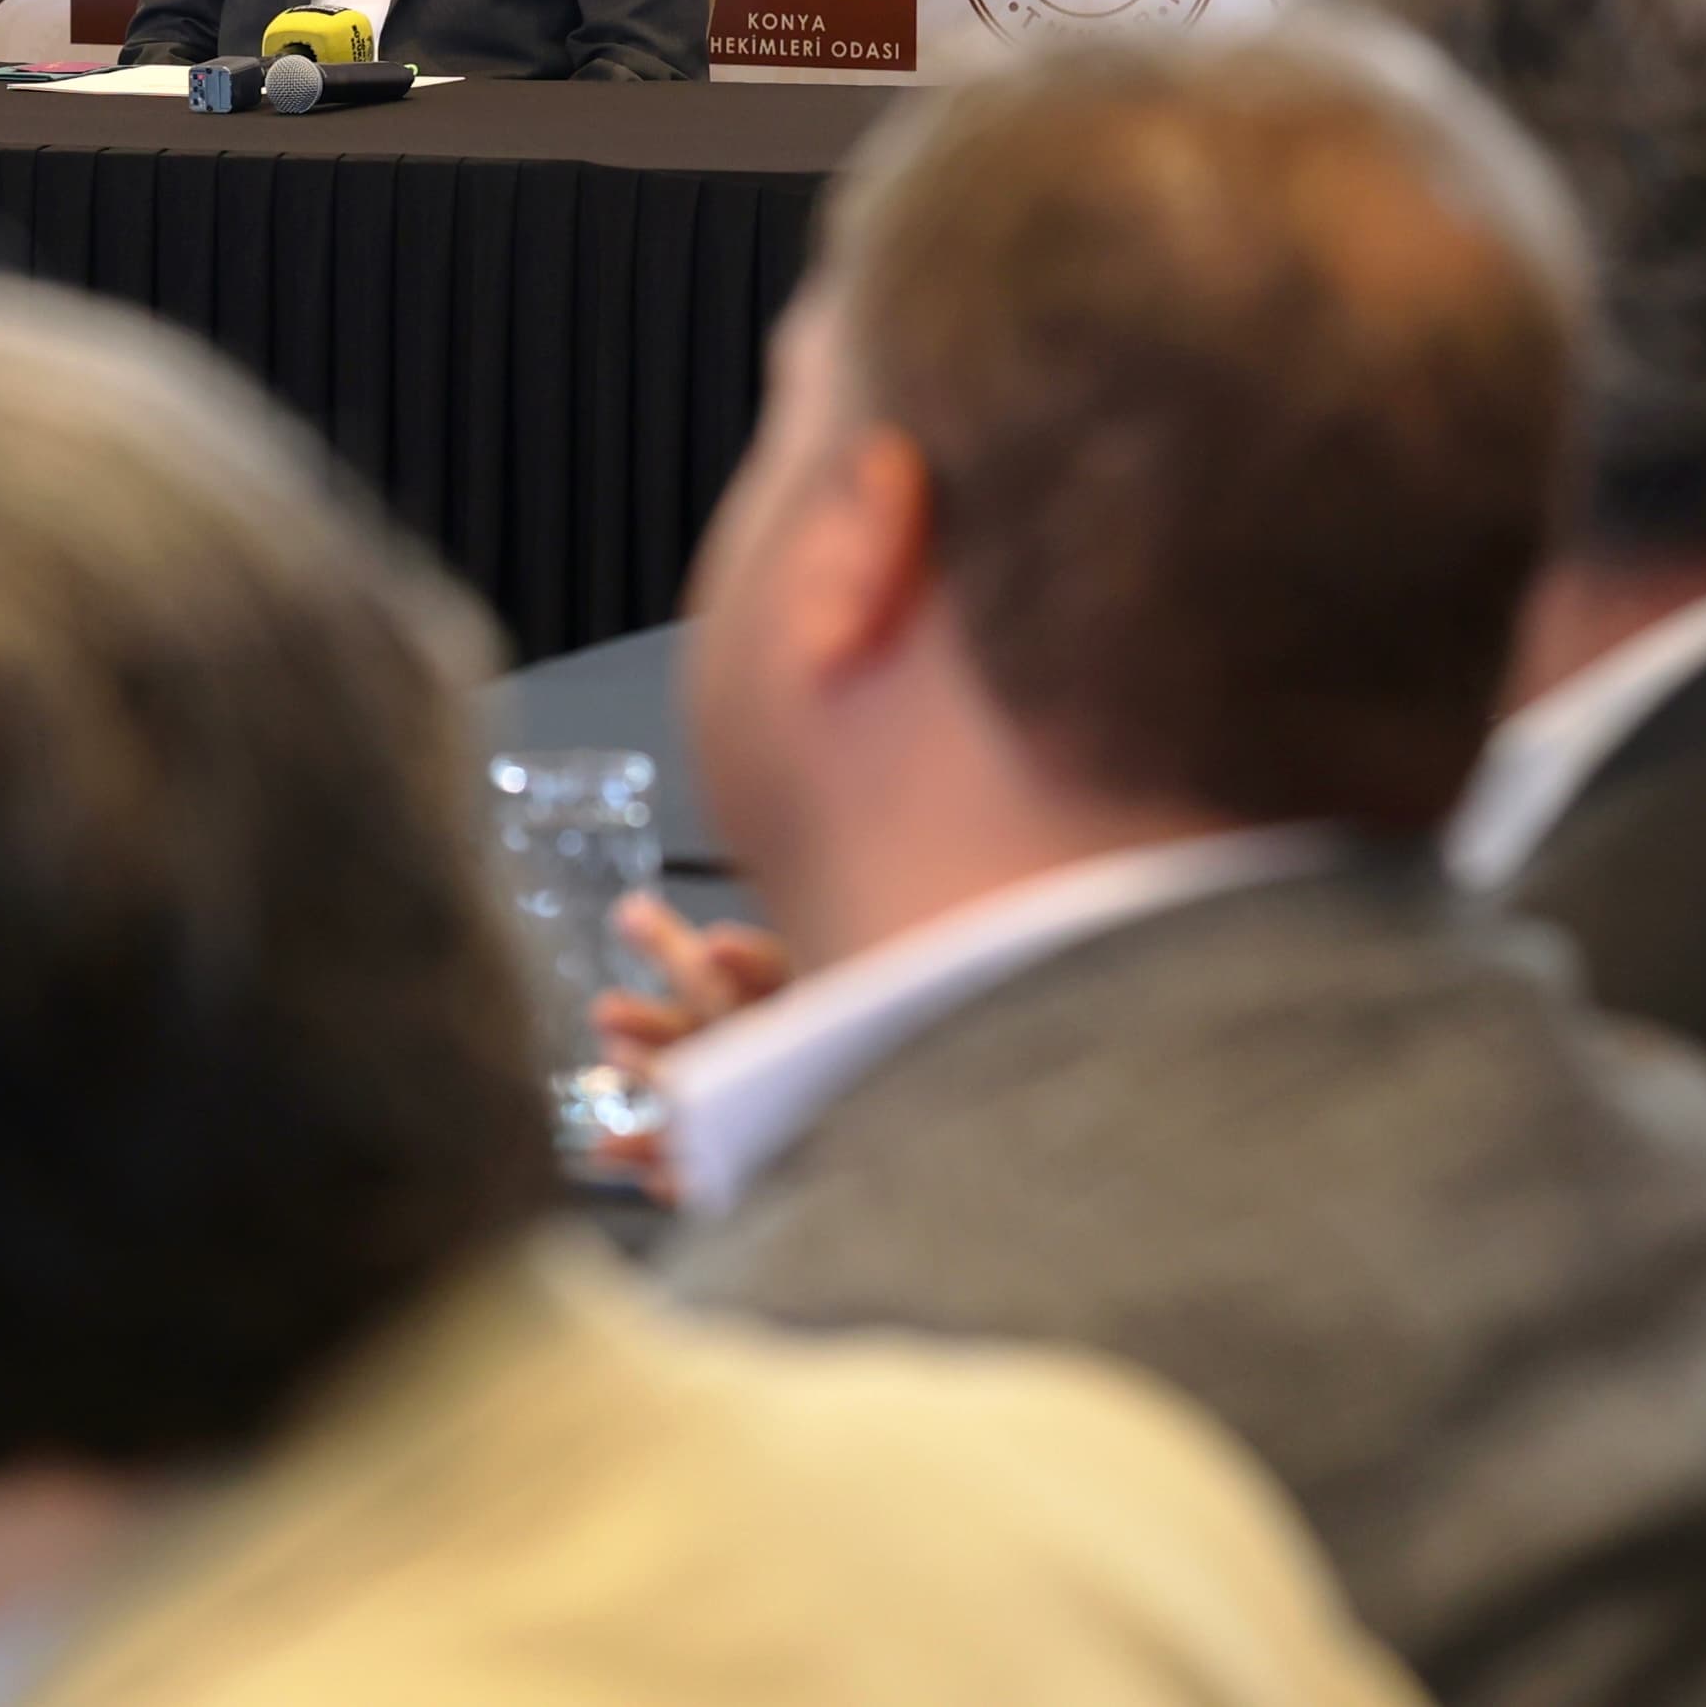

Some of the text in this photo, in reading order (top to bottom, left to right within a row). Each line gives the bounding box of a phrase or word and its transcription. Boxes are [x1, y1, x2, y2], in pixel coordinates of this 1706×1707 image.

[748, 12, 826, 32] KONYA
[710, 34, 900, 60] HEKİMLERİ ODASI
